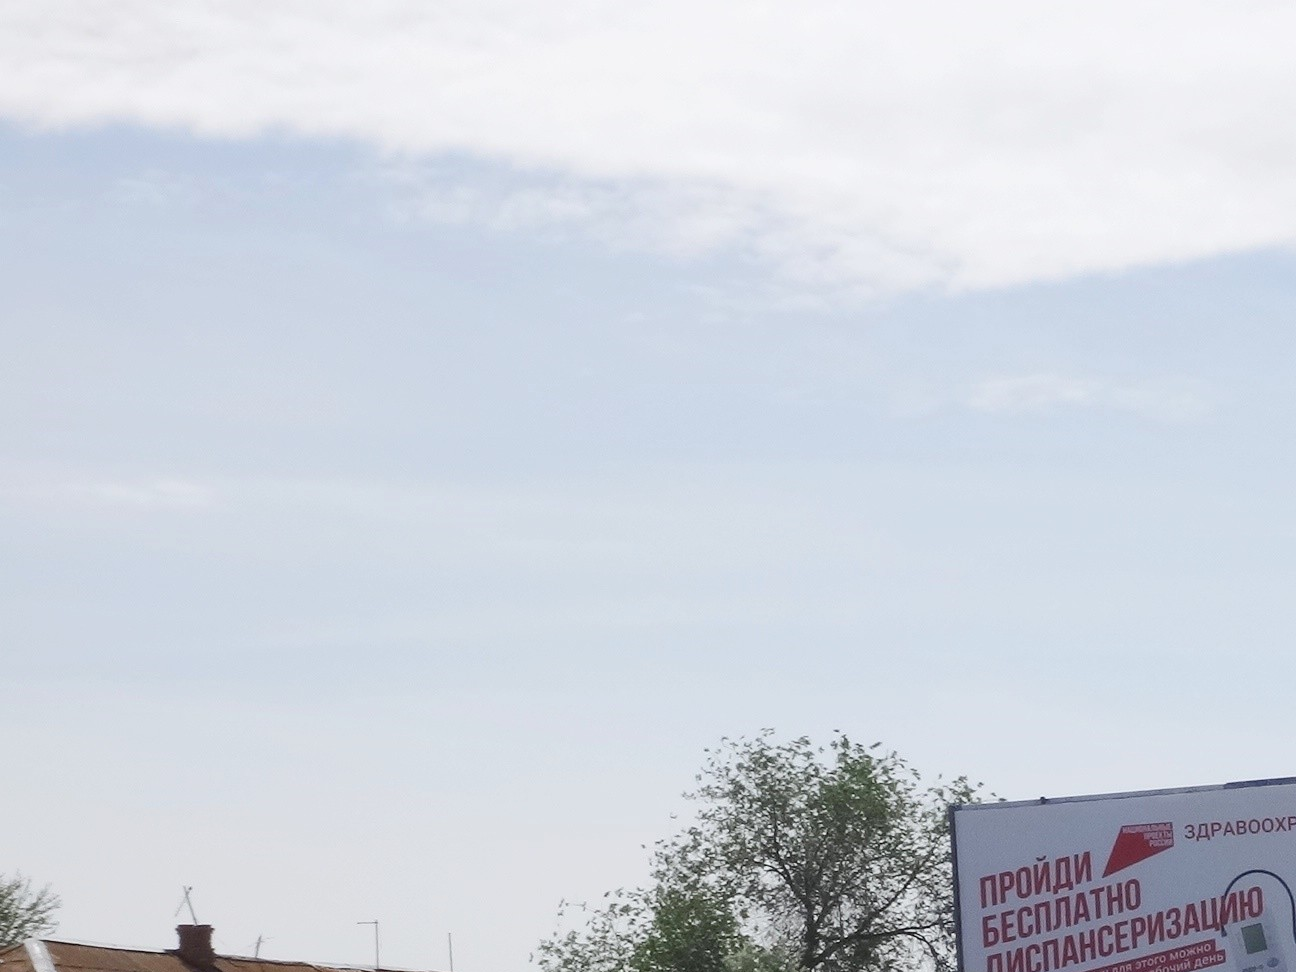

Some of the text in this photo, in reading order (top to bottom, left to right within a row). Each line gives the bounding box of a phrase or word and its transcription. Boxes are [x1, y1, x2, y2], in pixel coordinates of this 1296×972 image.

[979, 851, 1092, 909] ПРОЙДИ
[982, 878, 1141, 948] БЕСПЛАТНО
[1135, 955, 1166, 971] этого
[1169, 943, 1212, 960] можно
[1194, 952, 1225, 971] день
